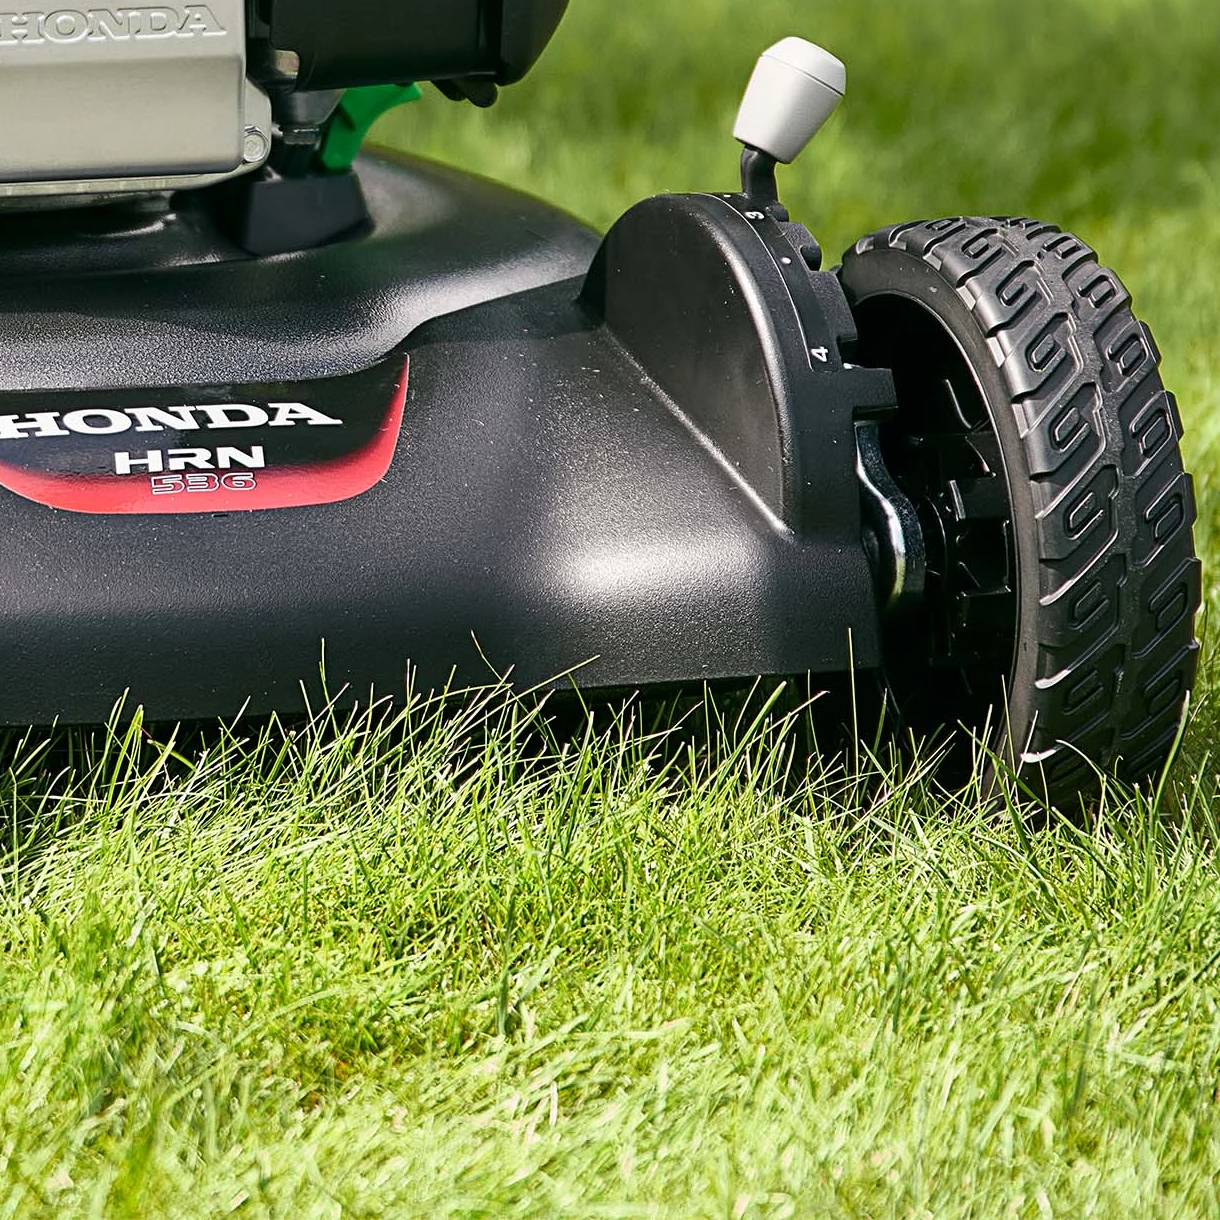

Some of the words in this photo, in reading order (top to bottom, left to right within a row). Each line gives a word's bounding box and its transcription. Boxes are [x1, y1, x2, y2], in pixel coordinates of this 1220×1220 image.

[746, 210, 765, 221] 3
[811, 346, 829, 363] 4
[114, 446, 265, 475] HRN
[151, 474, 256, 495] 536
